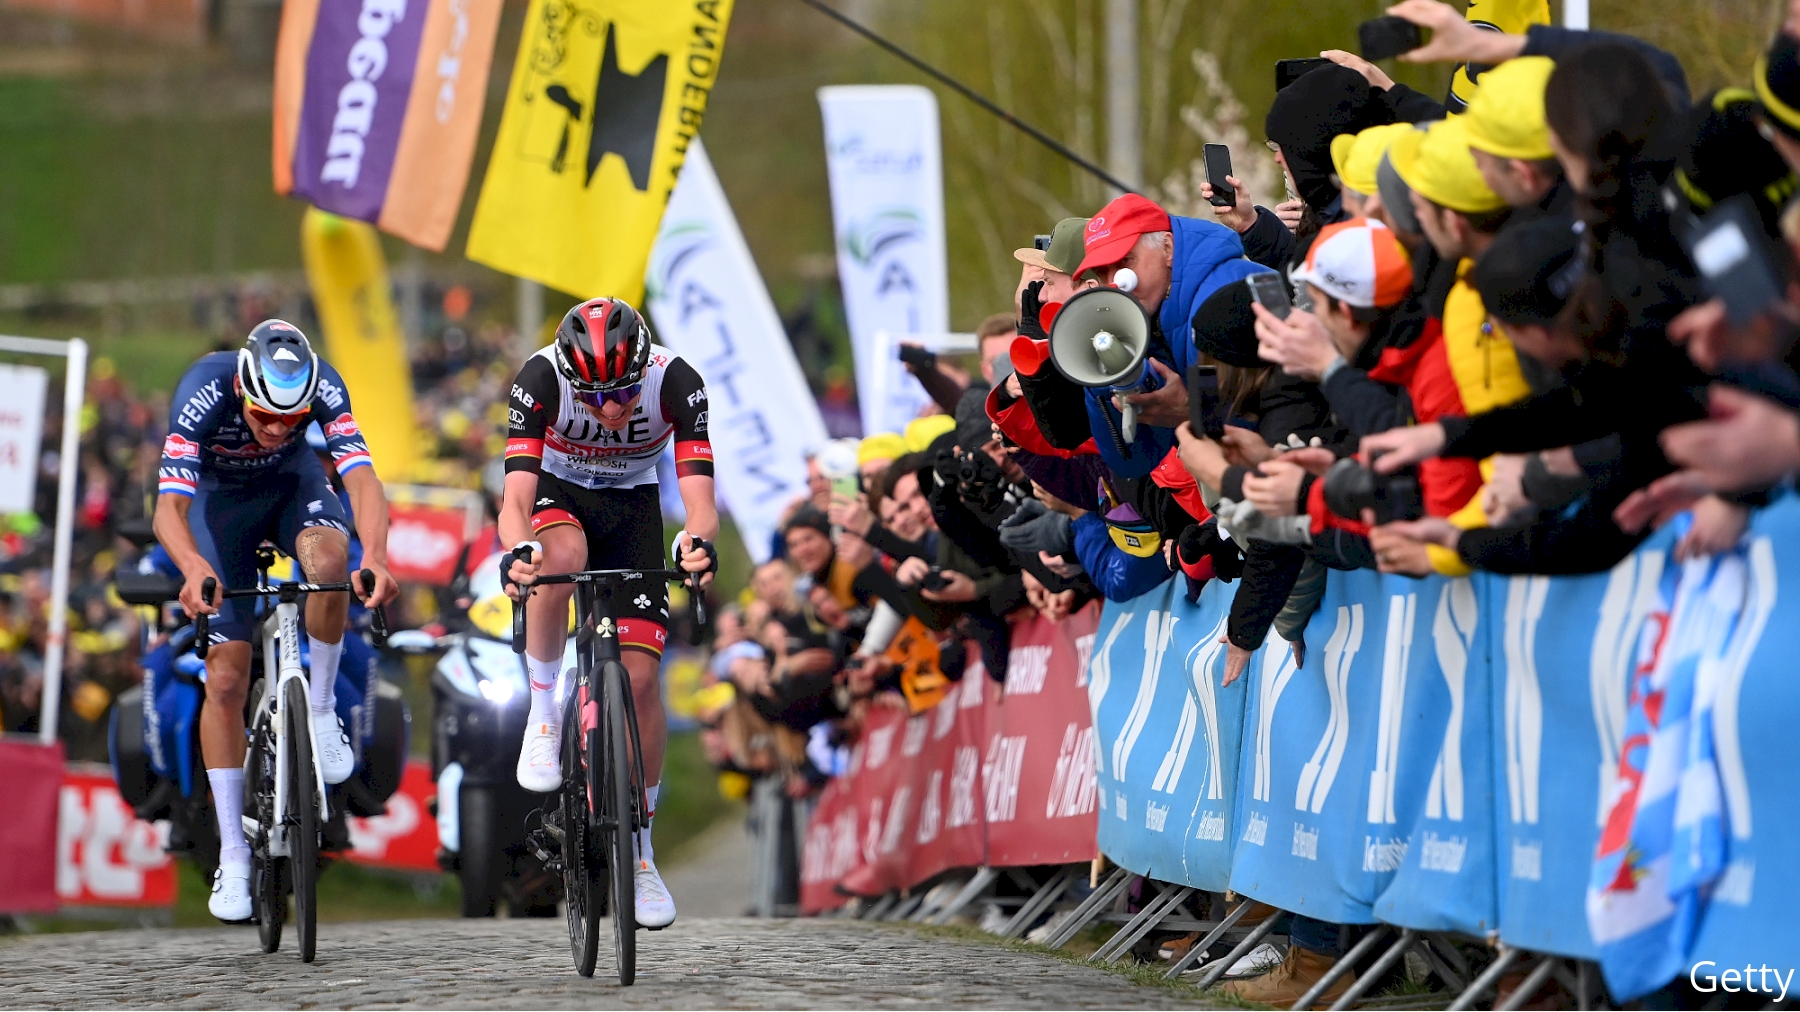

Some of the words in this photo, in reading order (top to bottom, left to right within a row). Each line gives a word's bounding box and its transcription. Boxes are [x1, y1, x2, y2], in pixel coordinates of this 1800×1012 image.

[177, 381, 224, 432] FENIX
[510, 384, 535, 409] FAB
[562, 418, 652, 444] UAE
[567, 456, 628, 469] WHOOSH
